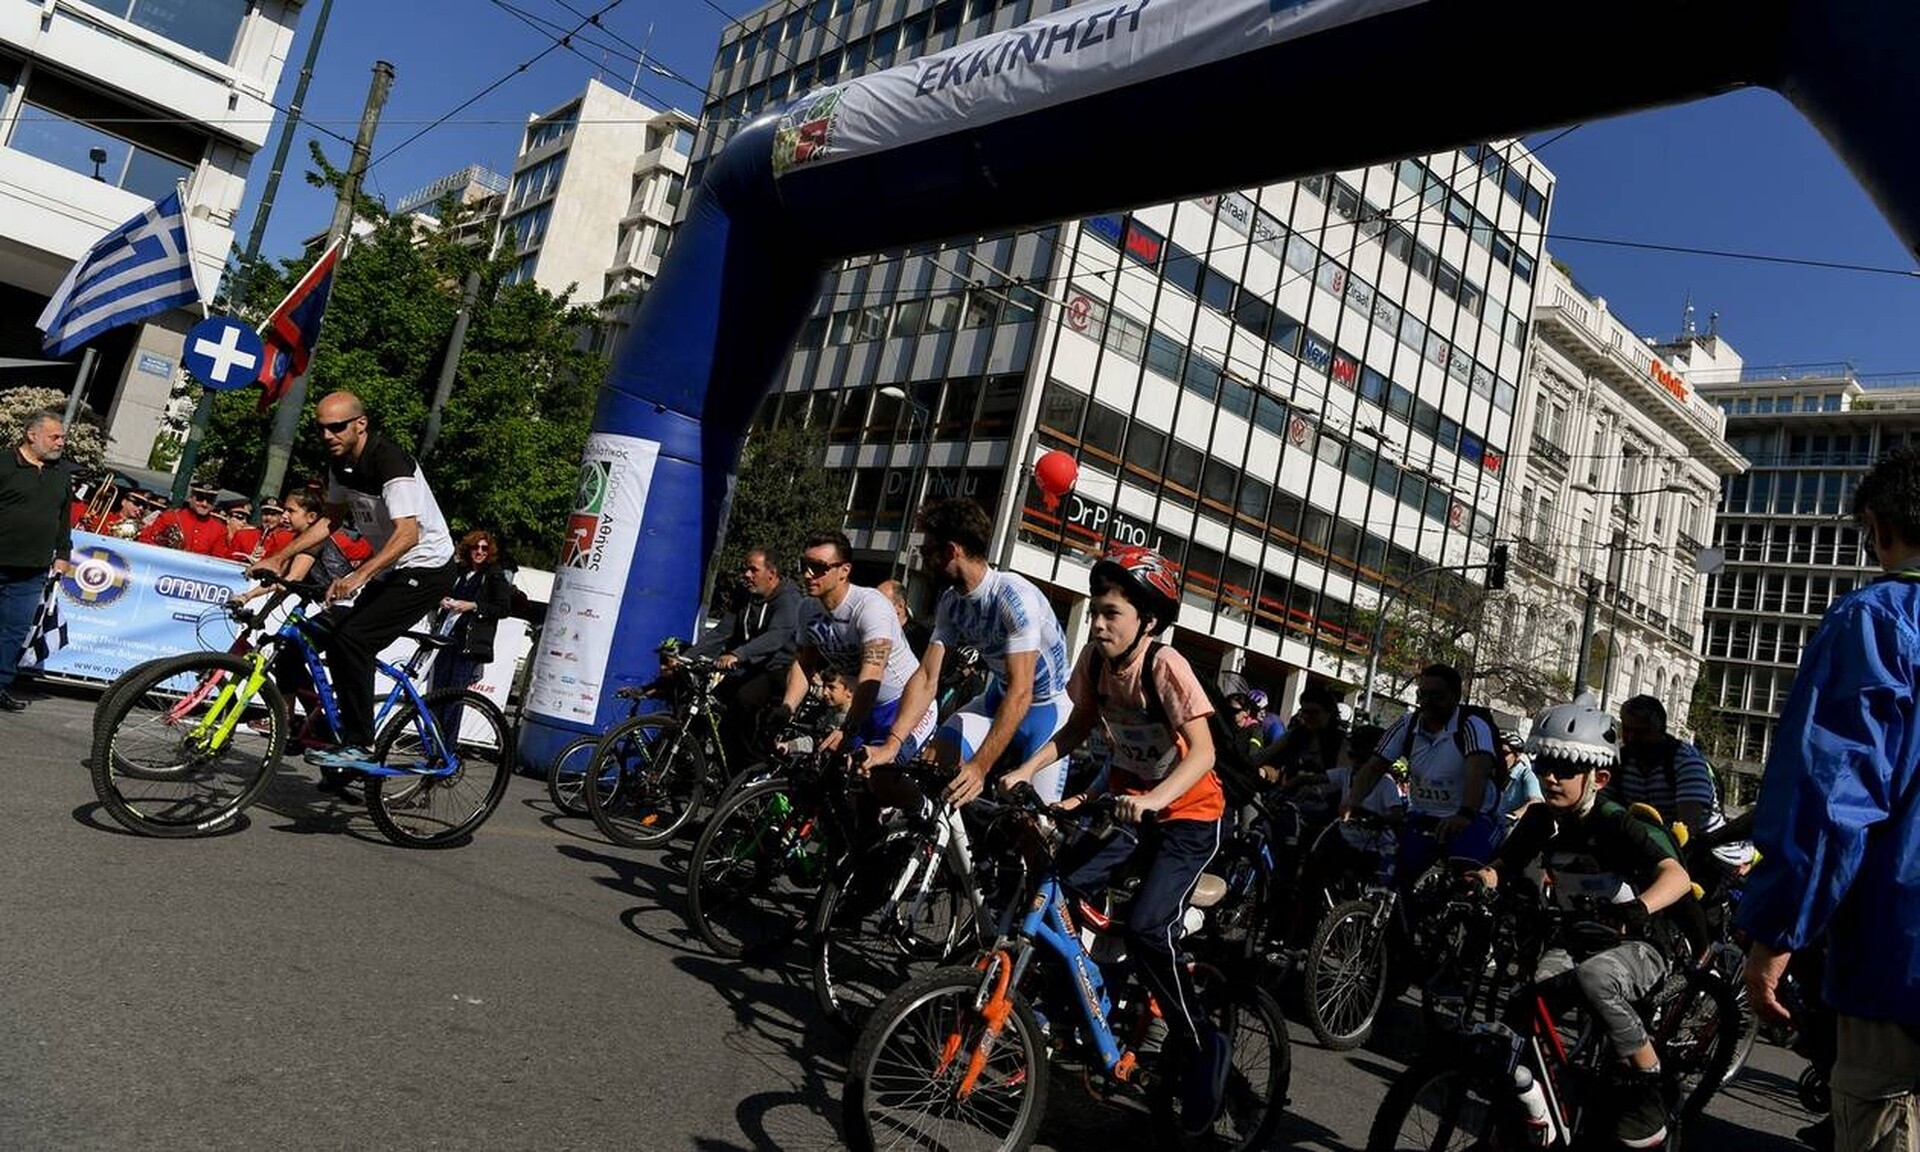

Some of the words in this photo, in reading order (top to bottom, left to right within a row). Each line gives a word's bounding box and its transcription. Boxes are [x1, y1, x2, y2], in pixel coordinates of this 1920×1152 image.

[914, 0, 1149, 98] ΕΚΚΙΝΗΣΗ
[1218, 193, 1248, 223] Ziraat
[1253, 216, 1278, 246] Bank
[1345, 281, 1370, 309] Ziraat
[1373, 302, 1394, 326] Bank
[588, 513, 614, 572] Αθήνας
